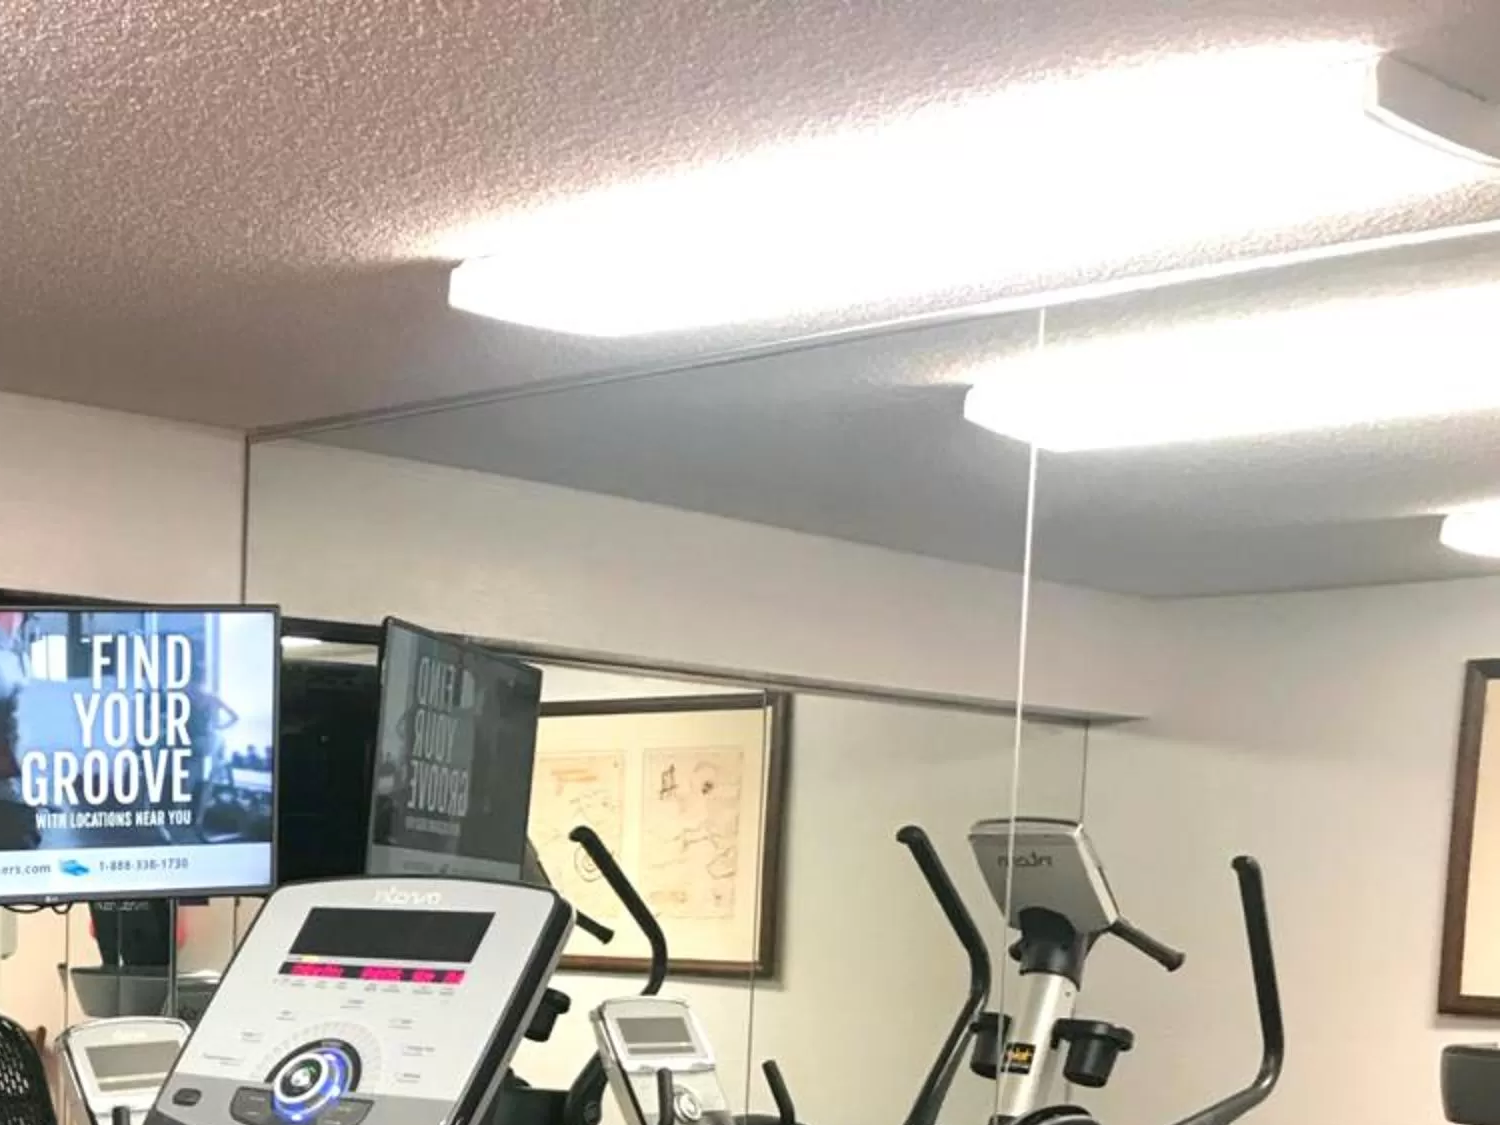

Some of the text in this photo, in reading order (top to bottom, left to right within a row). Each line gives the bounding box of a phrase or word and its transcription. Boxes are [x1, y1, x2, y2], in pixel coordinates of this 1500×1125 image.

[92, 634, 192, 690] FIND
[73, 692, 192, 748] YOUR
[21, 748, 193, 807] GROOVE
[36, 808, 192, 829] WITH LOCATIONS NEAR YOU
